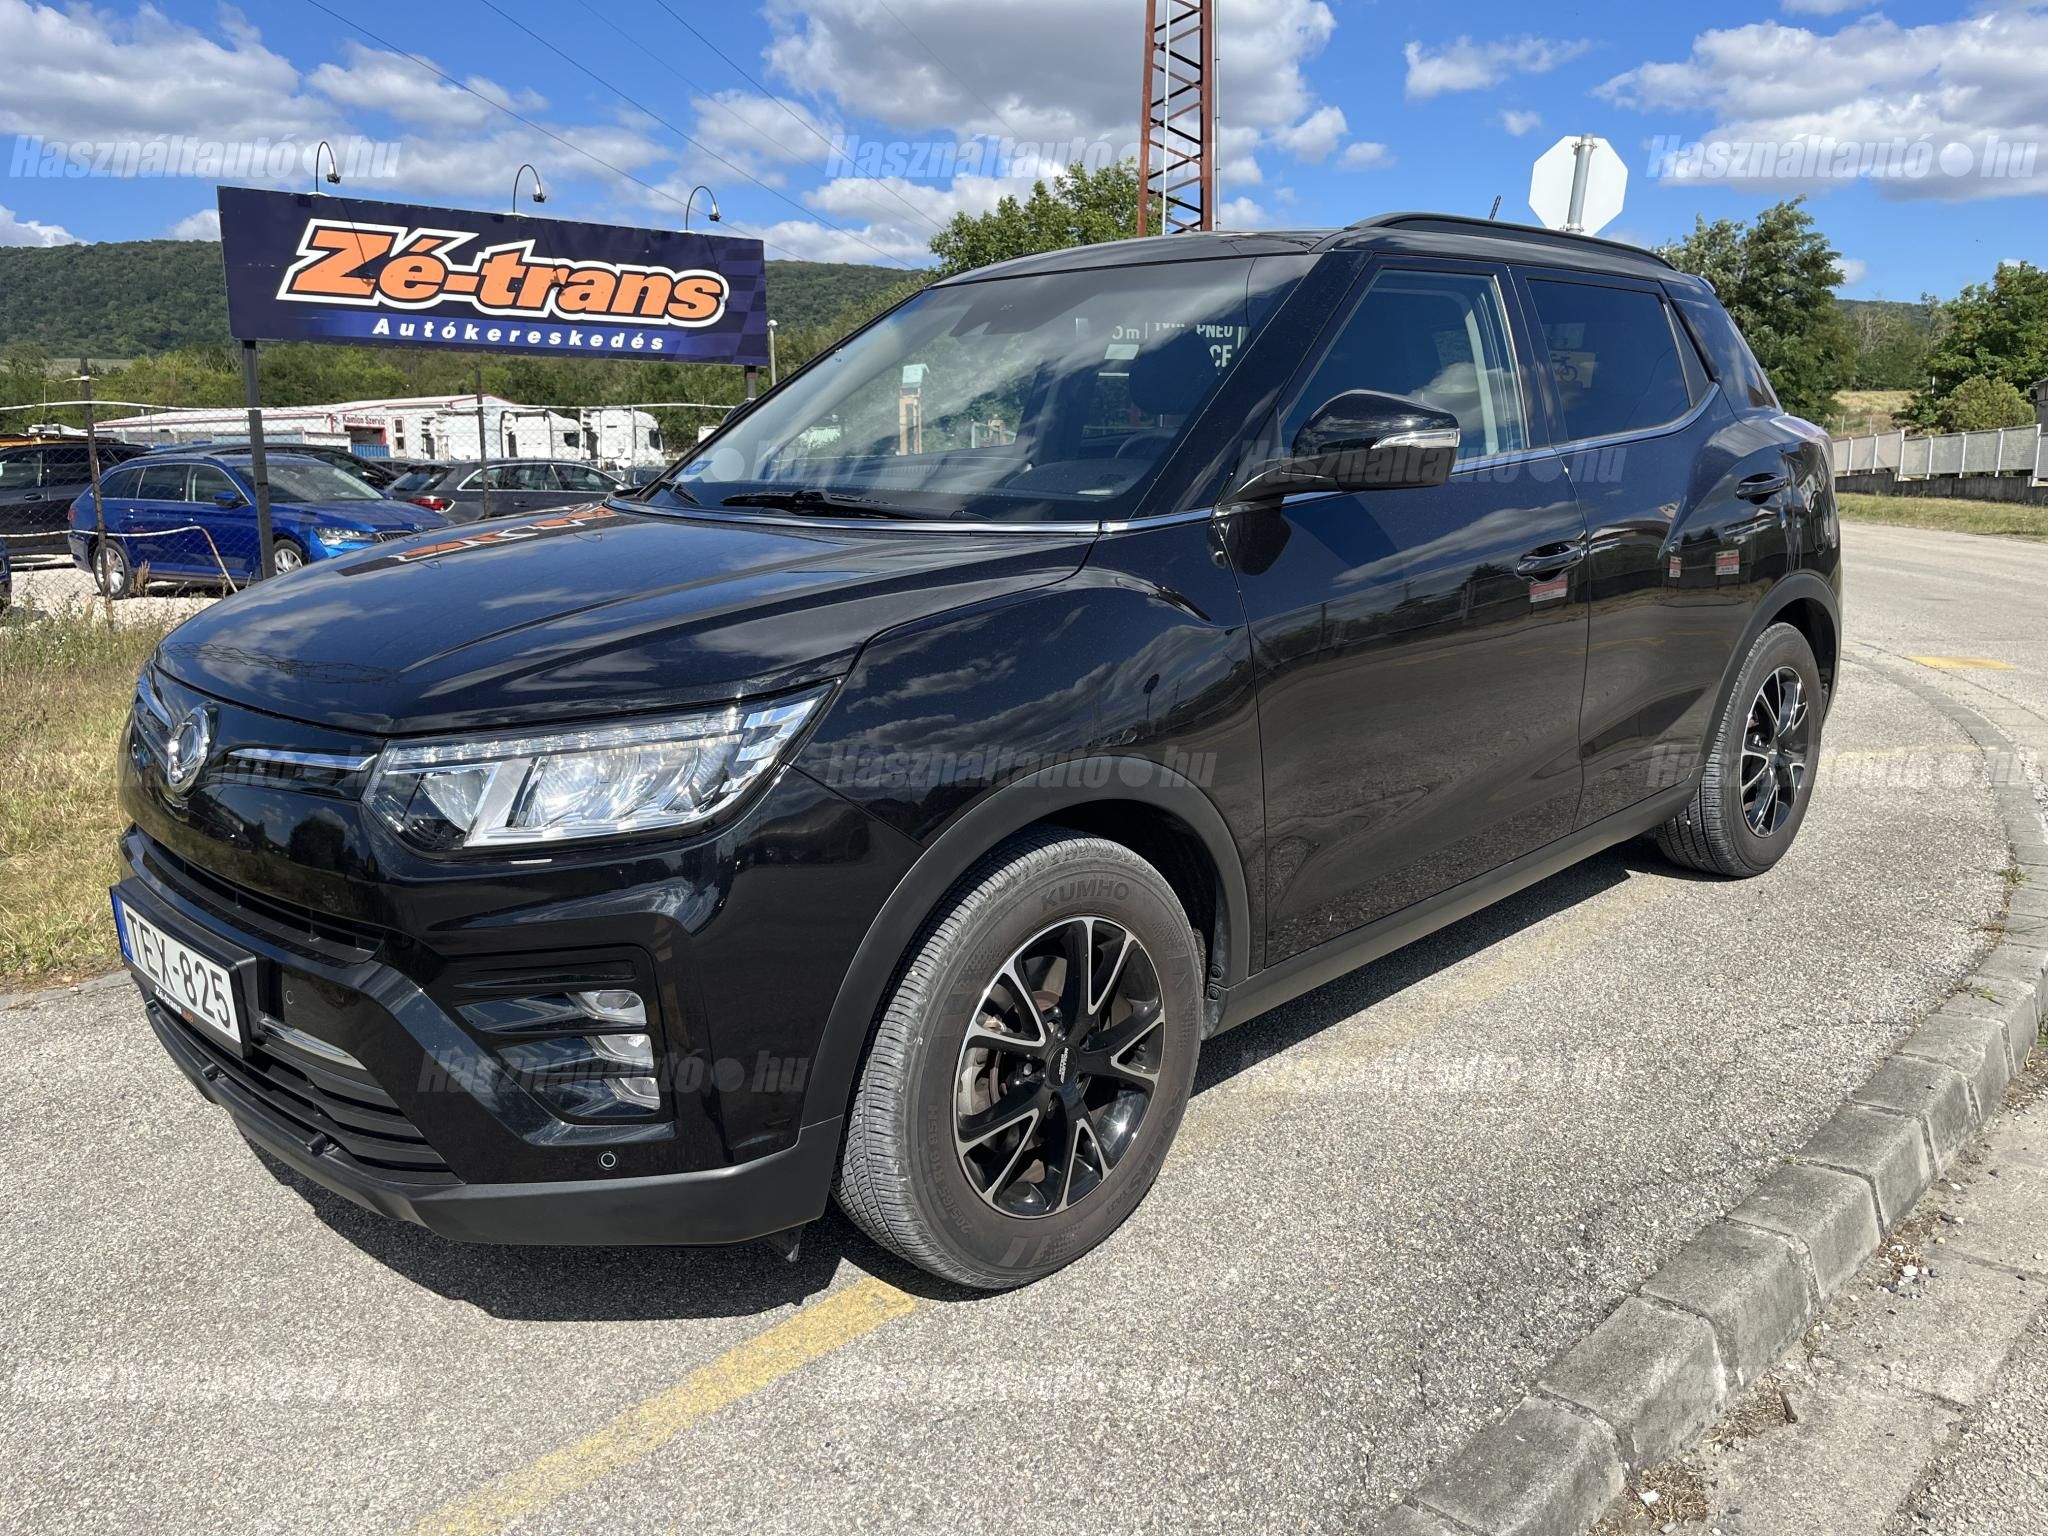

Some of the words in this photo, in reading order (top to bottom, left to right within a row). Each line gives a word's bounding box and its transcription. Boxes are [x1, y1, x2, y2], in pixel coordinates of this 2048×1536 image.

[278, 219, 728, 326] Zé-trans
[372, 318, 664, 351] Autókereskedés
[343, 414, 364, 424] Kamion
[365, 415, 386, 425] Szerviz
[1040, 879, 1130, 912] KUMHO
[126, 910, 231, 1029] TEX-825
